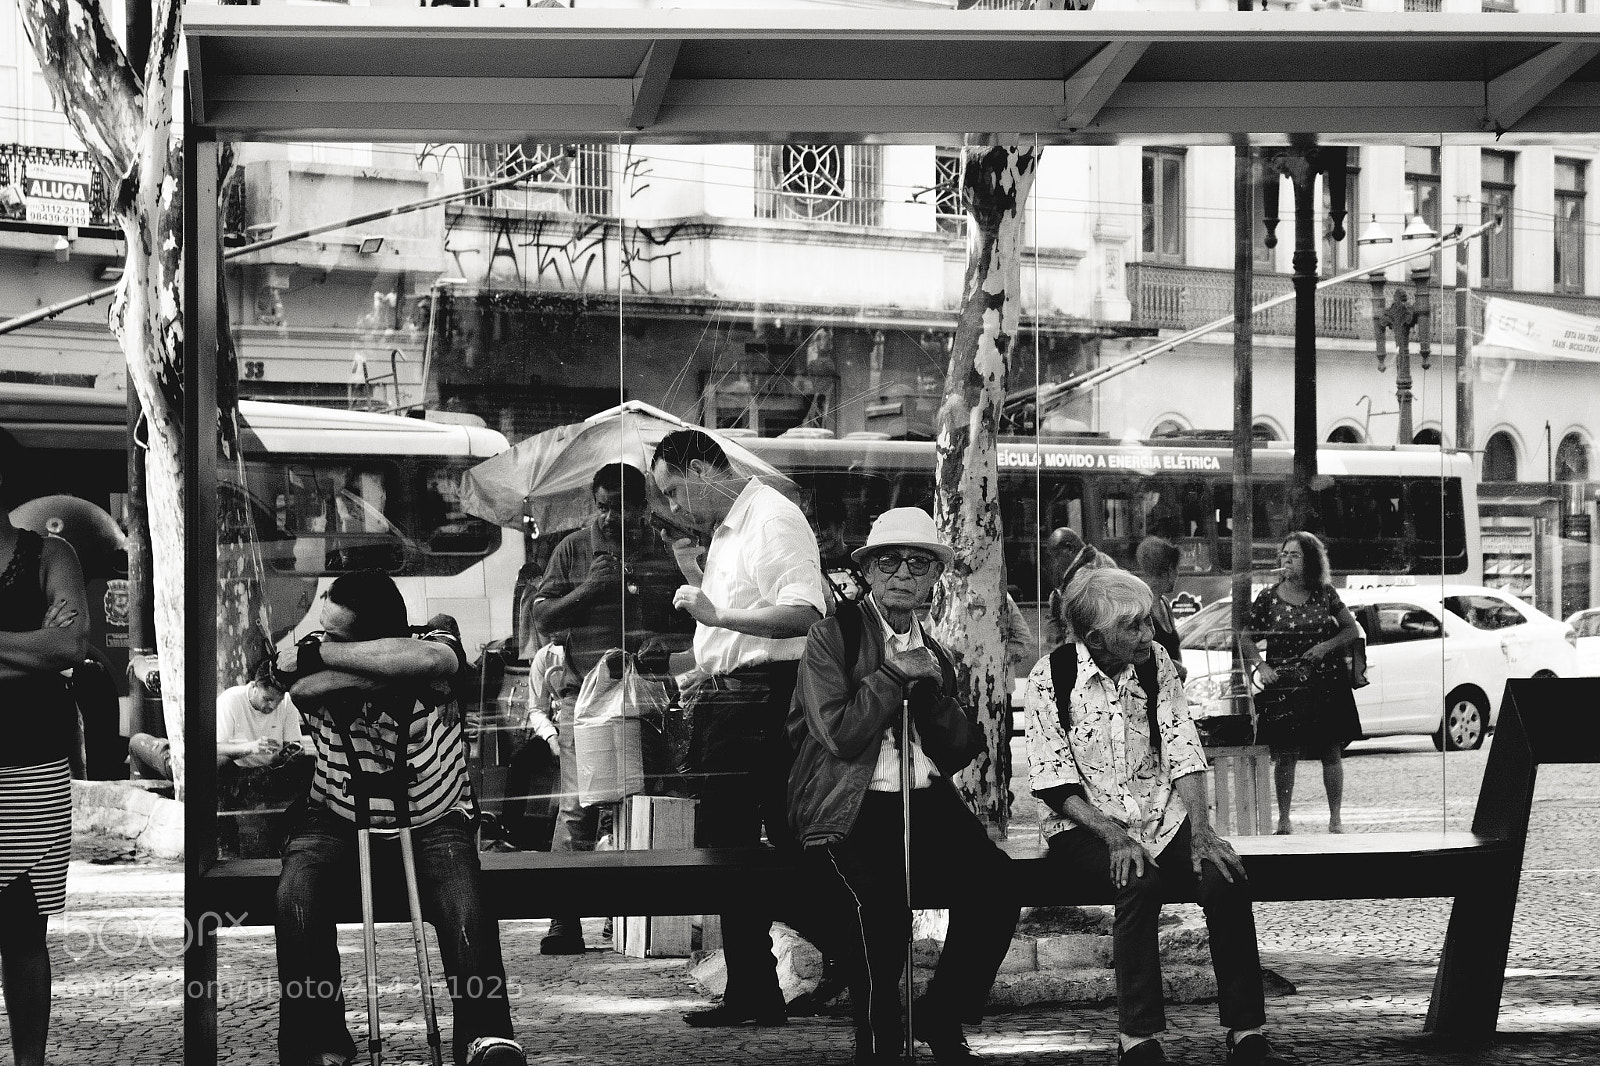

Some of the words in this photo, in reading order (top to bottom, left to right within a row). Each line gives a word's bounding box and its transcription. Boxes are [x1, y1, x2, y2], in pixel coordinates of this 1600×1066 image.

[30, 180, 86, 201] ALUGA
[41, 204, 86, 216] 3112-2113
[244, 361, 265, 379] 33
[997, 449, 1041, 468] EÍCULO
[1044, 452, 1095, 468] MOVIDO
[1097, 453, 1107, 468] A
[1108, 453, 1162, 469] ENERGIA
[1163, 452, 1221, 470] ELÉTRICA
